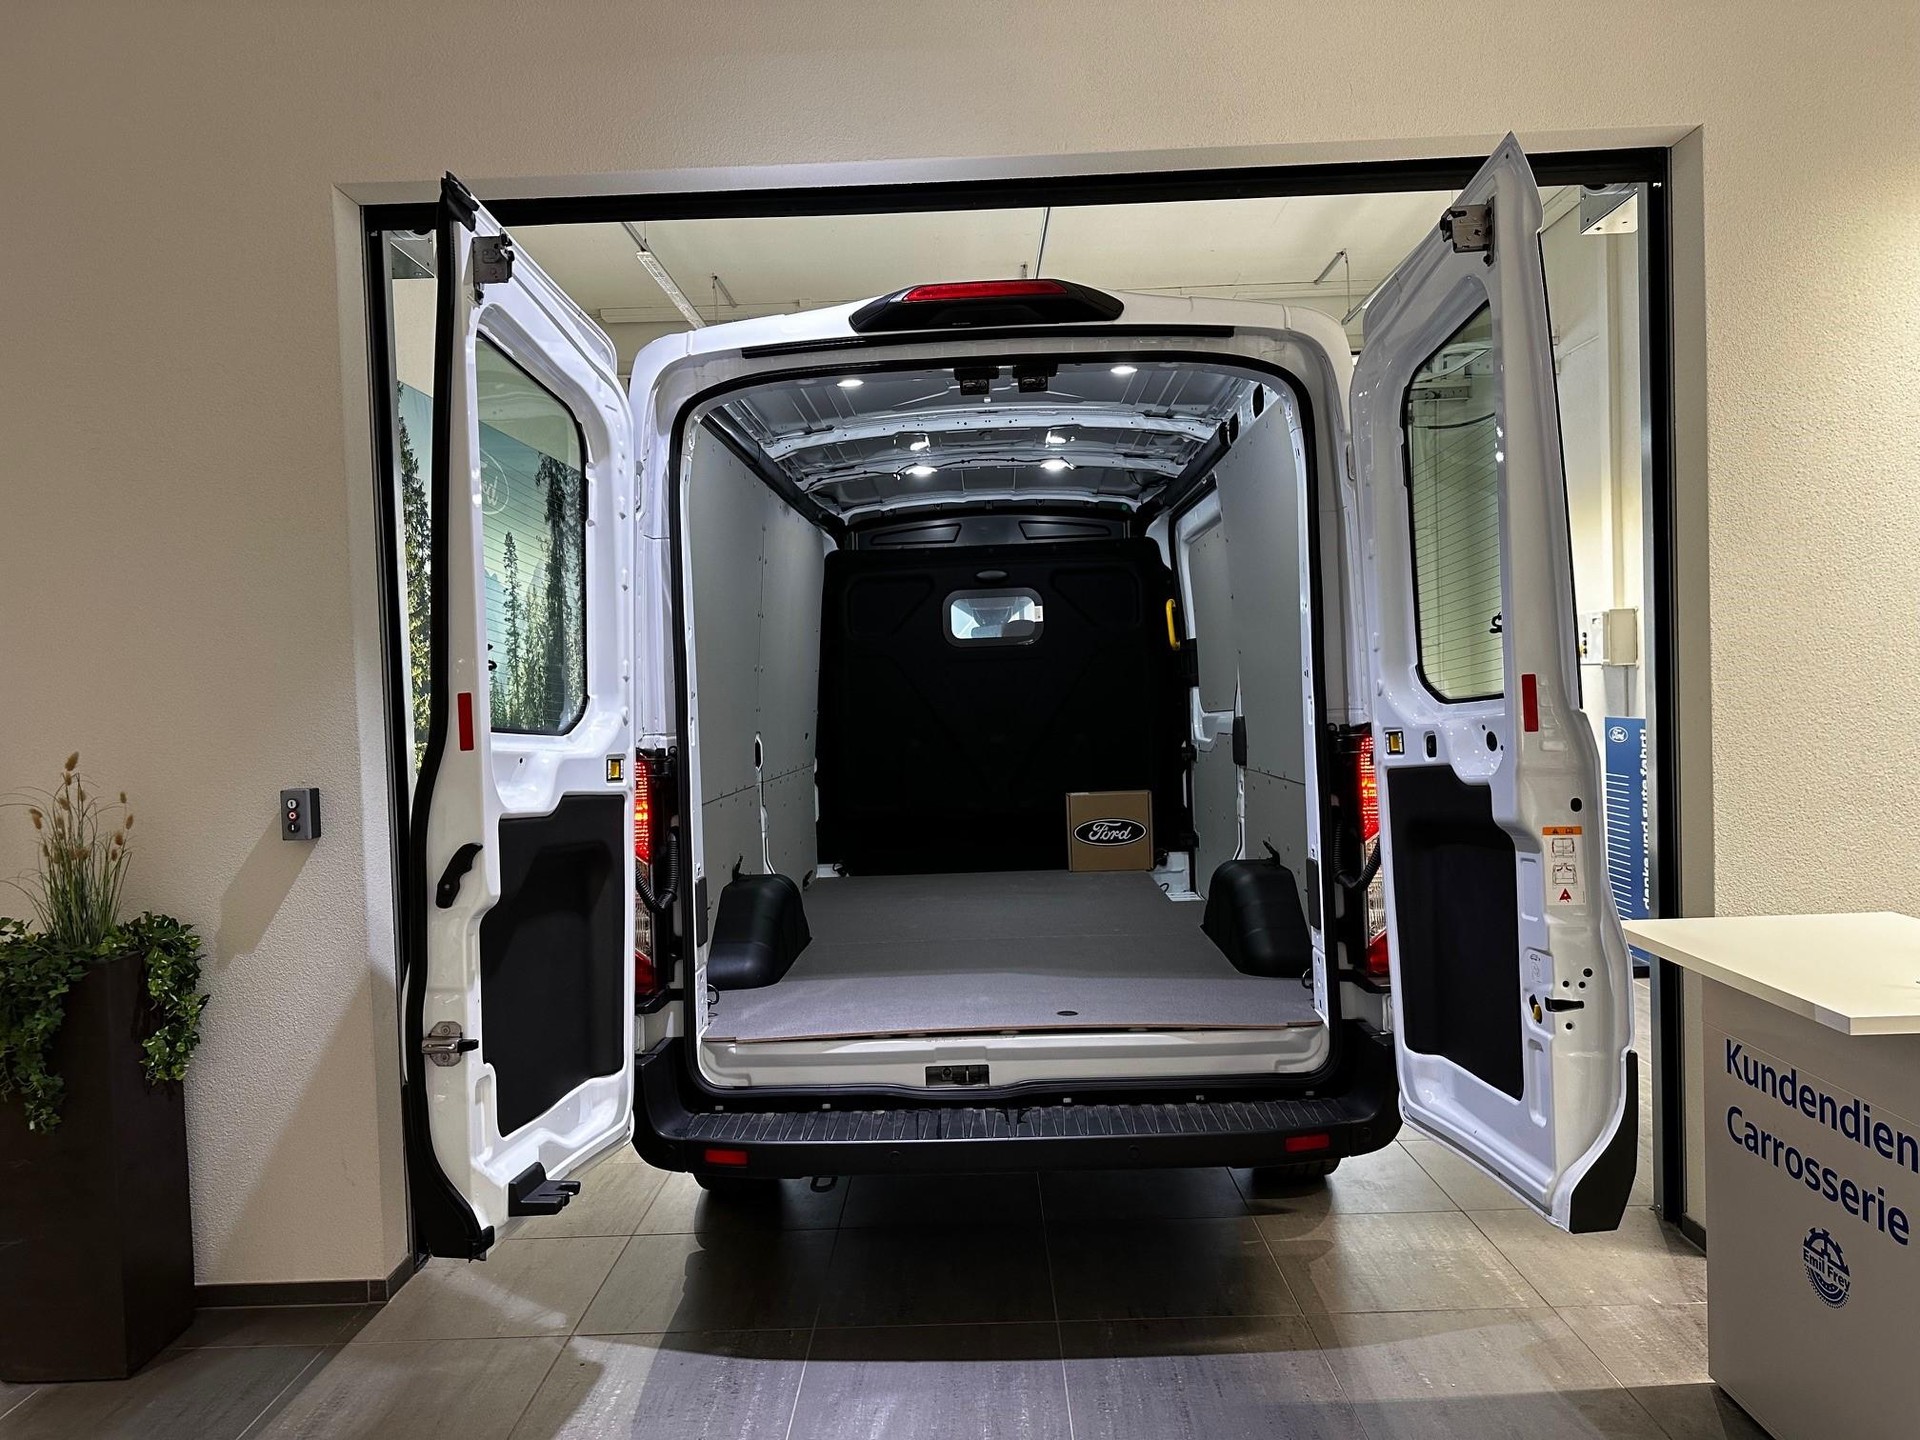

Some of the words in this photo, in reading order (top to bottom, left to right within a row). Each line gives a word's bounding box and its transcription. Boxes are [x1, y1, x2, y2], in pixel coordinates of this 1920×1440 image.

[1088, 822, 1132, 841] Ford
[1725, 1038, 1920, 1174] Kundendien
[1726, 1105, 1910, 1246] Carrosserie
[1803, 1247, 1825, 1274] Emil
[1827, 1264, 1850, 1293] Frey
